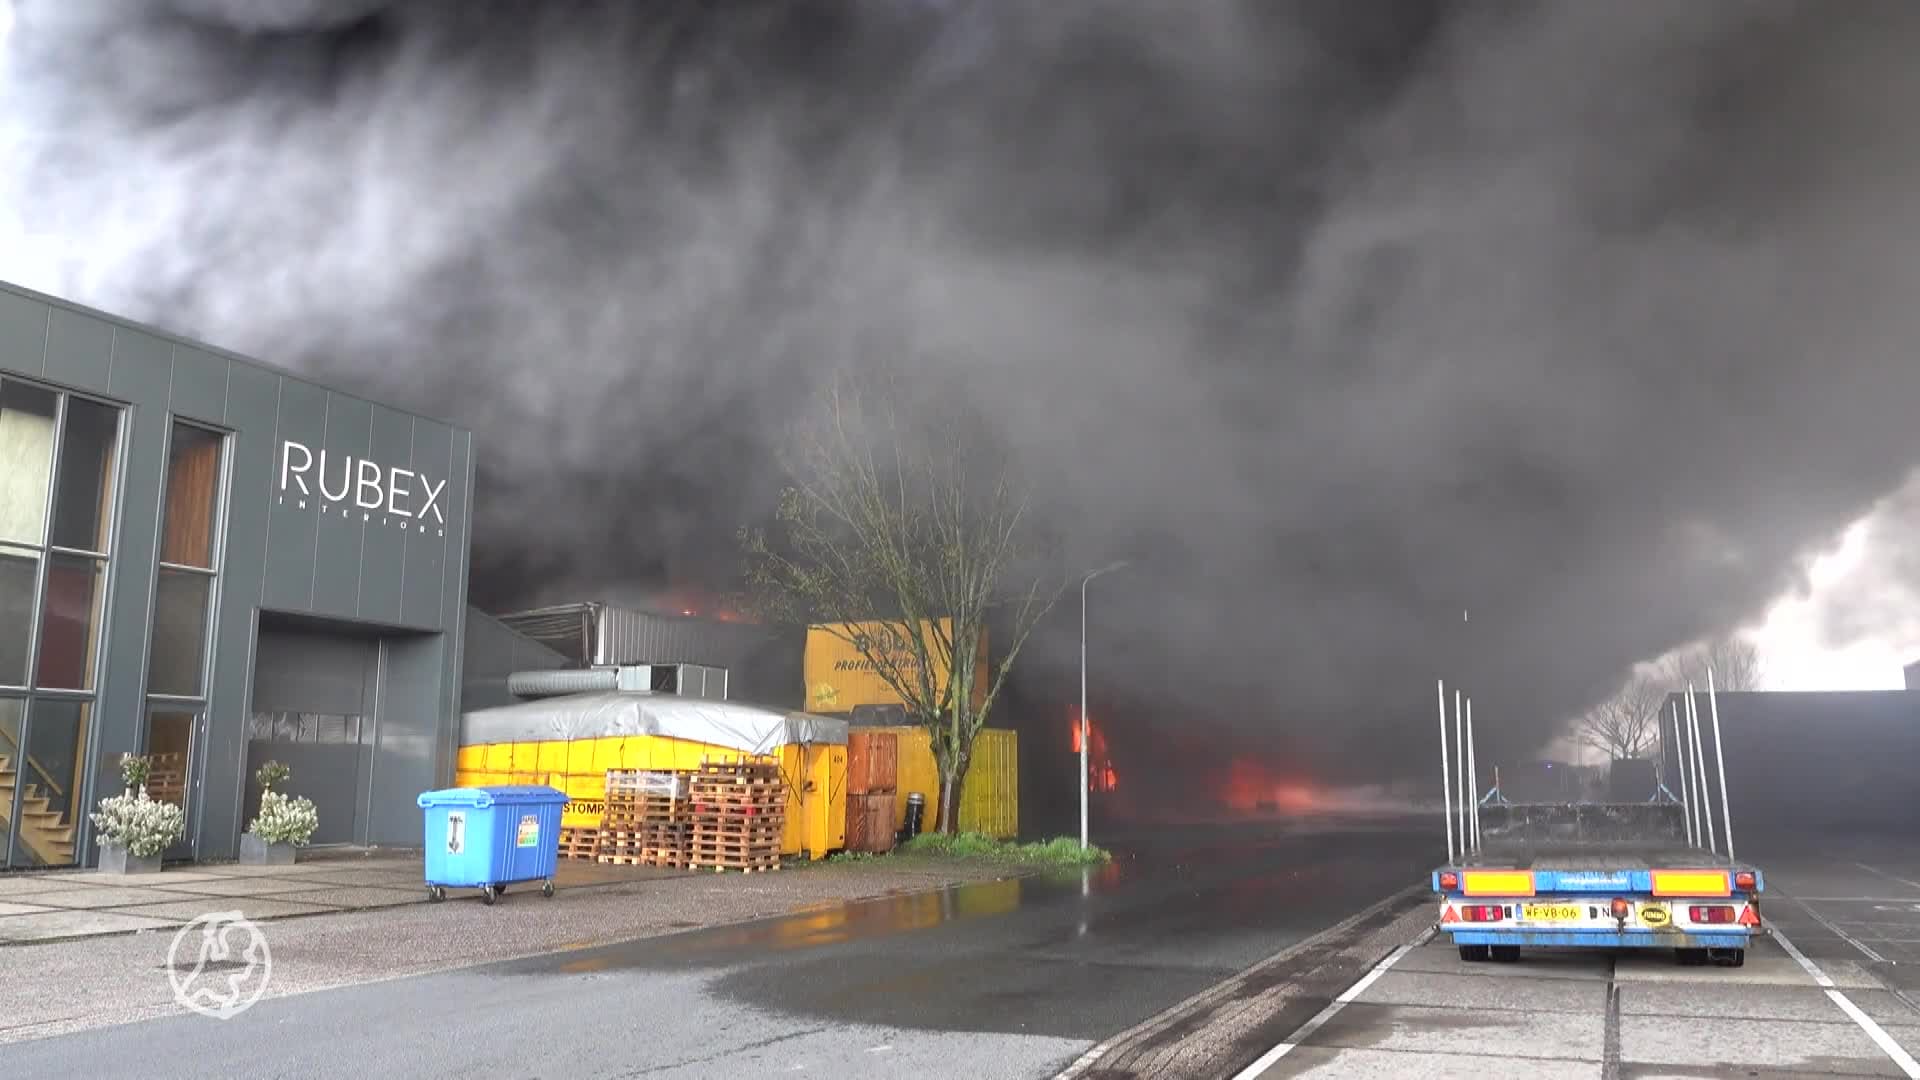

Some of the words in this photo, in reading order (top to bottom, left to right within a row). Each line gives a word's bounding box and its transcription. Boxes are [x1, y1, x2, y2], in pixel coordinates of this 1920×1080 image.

[281, 440, 446, 524] RUBEX
[279, 495, 443, 537] INTERIORS
[1643, 911, 1665, 920] JUMBO
